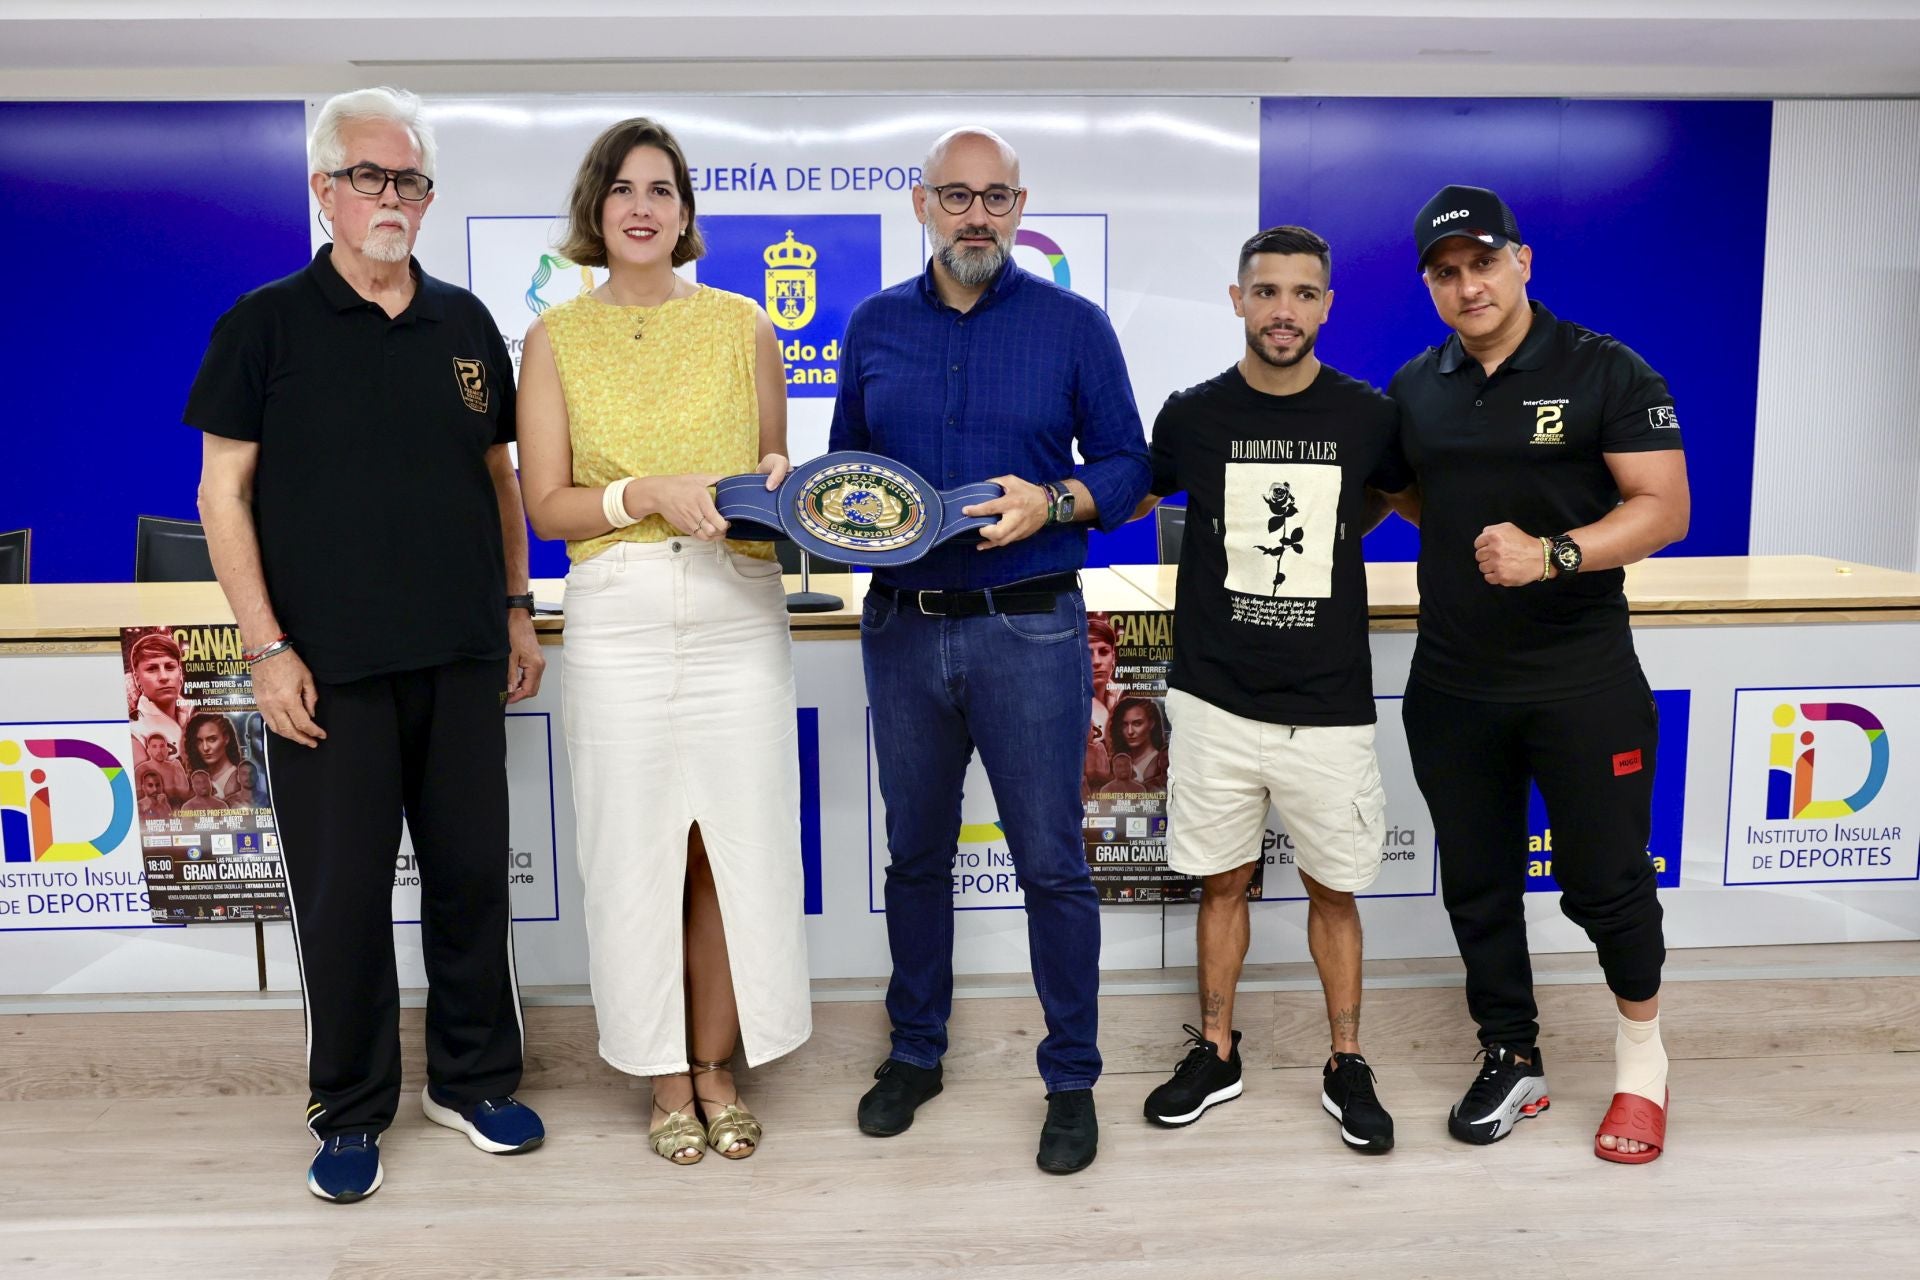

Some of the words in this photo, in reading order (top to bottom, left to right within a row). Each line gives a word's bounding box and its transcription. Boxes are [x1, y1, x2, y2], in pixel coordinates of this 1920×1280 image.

[690, 162, 777, 192] EJERÍA
[786, 167, 822, 191] DE
[830, 167, 923, 192] DEPOR
[1432, 209, 1470, 228] HUGO
[1523, 398, 1570, 406] InterCanarias
[1231, 440, 1294, 459] BLOOMING
[1298, 441, 1337, 460] TALES
[813, 474, 877, 495] EUROPEAN
[881, 480, 914, 506] UNION
[830, 523, 892, 538] CHAMPION
[1110, 613, 1173, 647] CANA
[174, 627, 242, 661] CANA
[1119, 648, 1137, 657] CUNA
[1138, 648, 1147, 657] DE
[1149, 647, 1173, 660] CAM
[185, 662, 205, 673] CUNA
[206, 662, 215, 672] DE
[216, 661, 251, 676] CAMPE
[184, 681, 209, 689] ARAMIS
[1132, 682, 1152, 690] PÉREZ
[203, 697, 223, 706] PÉREZ
[229, 697, 256, 705] MINERV
[1096, 792, 1124, 800] COMBATES
[260, 807, 272, 816] COM
[1747, 826, 1828, 845] INSTITUTO
[1834, 823, 1901, 842] INSULAR
[1096, 846, 1129, 862] GRAN
[1752, 856, 1773, 870] DE
[1779, 847, 1891, 869] DEPORTES
[147, 860, 171, 871] 18:00
[183, 863, 217, 880] GRAN
[220, 862, 273, 880] CANARIA
[274, 862, 284, 878] A
[0, 872, 78, 888] NSTITUTO
[84, 867, 147, 887] INSULA
[28, 892, 152, 915] DEPORTES
